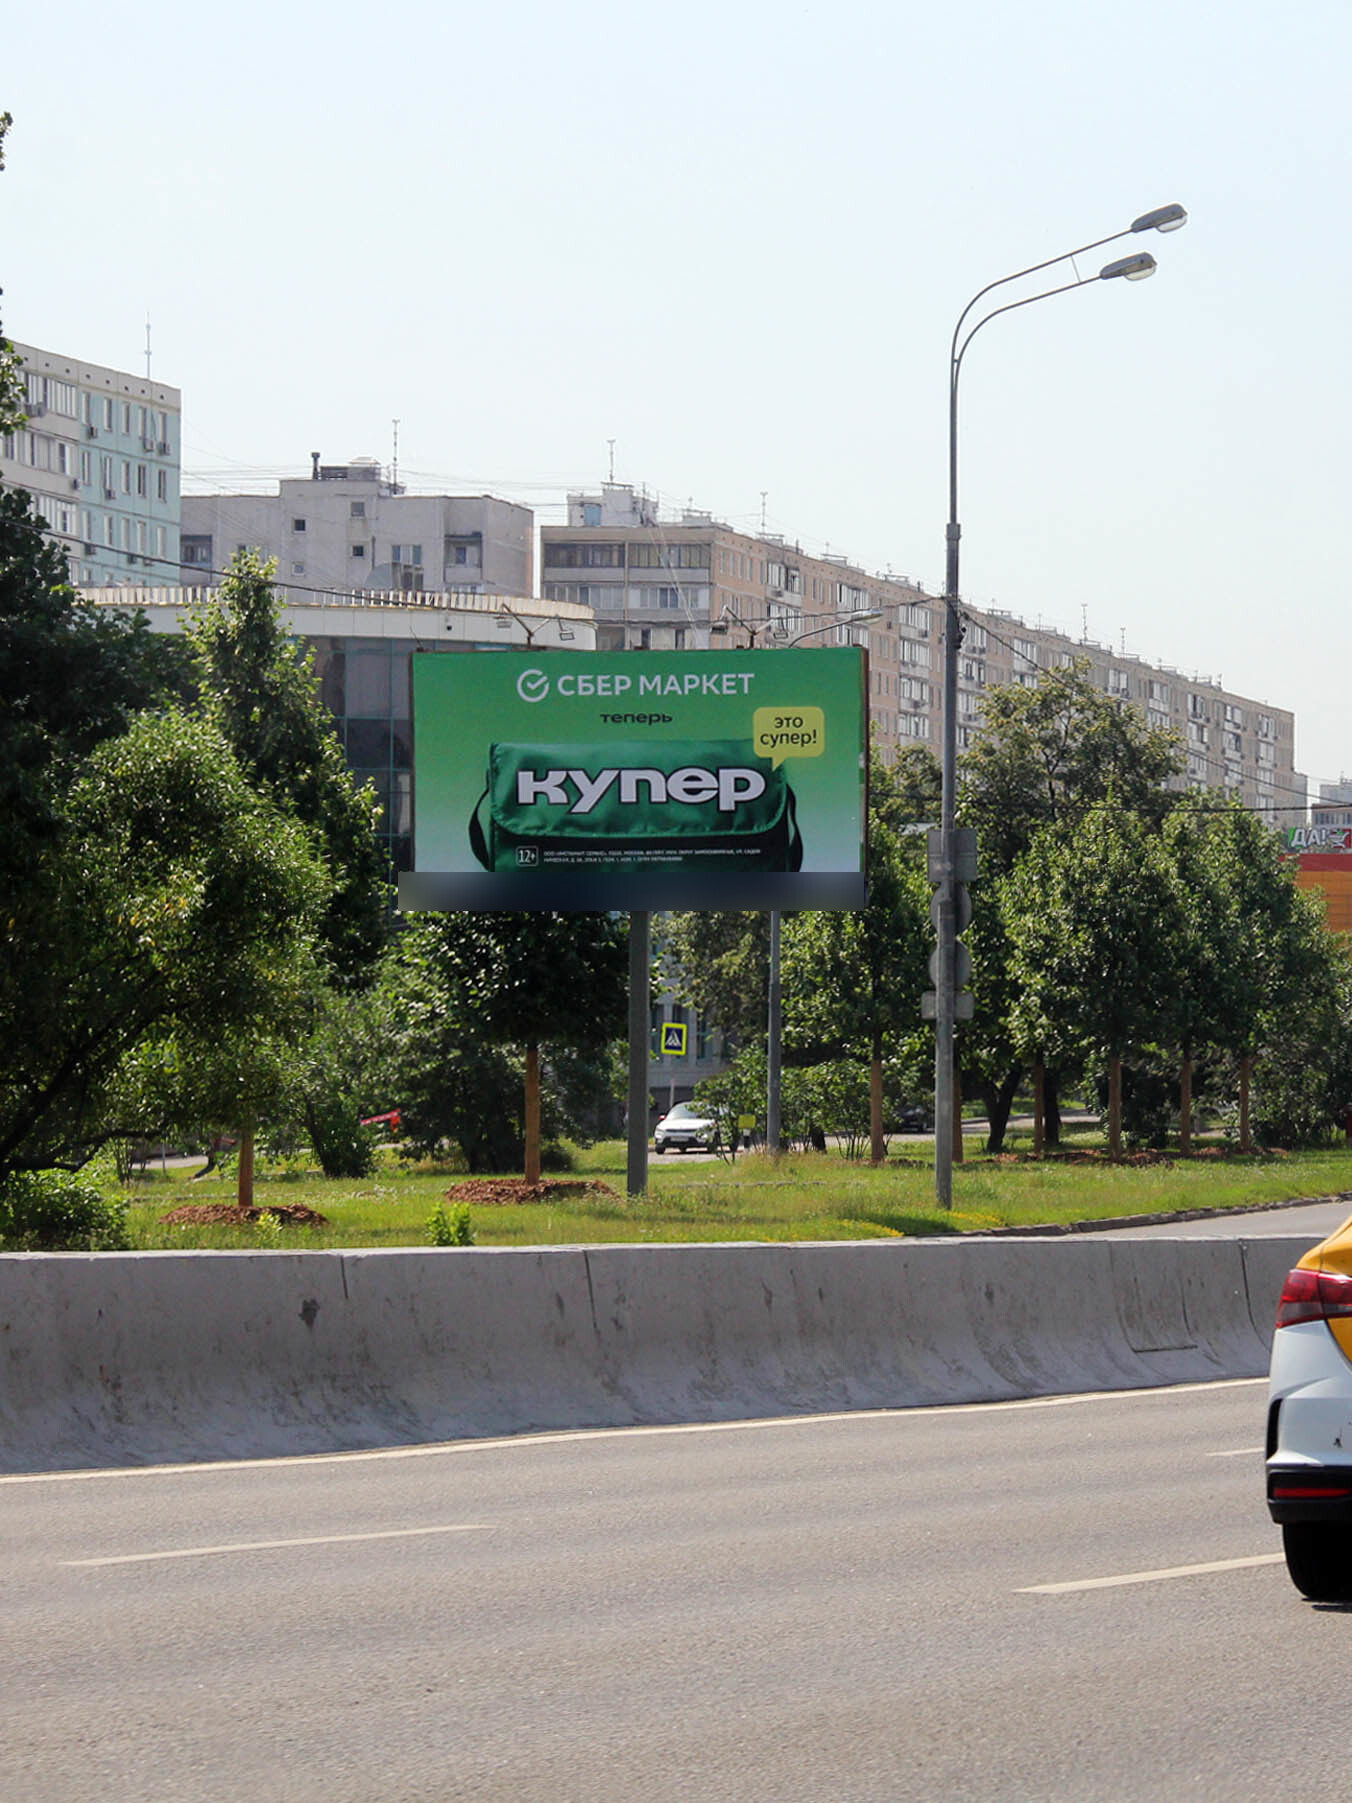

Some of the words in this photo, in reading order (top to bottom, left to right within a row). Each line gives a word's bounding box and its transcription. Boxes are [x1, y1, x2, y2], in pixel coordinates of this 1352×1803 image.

[557, 674, 632, 696] СБЕР
[639, 673, 755, 695] МАРКЕТ
[600, 712, 672, 726] теперь
[774, 717, 803, 729] это
[760, 729, 817, 748] супер!
[517, 767, 766, 814] купер
[1290, 828, 1326, 847] ДА!
[518, 849, 537, 863] 12+
